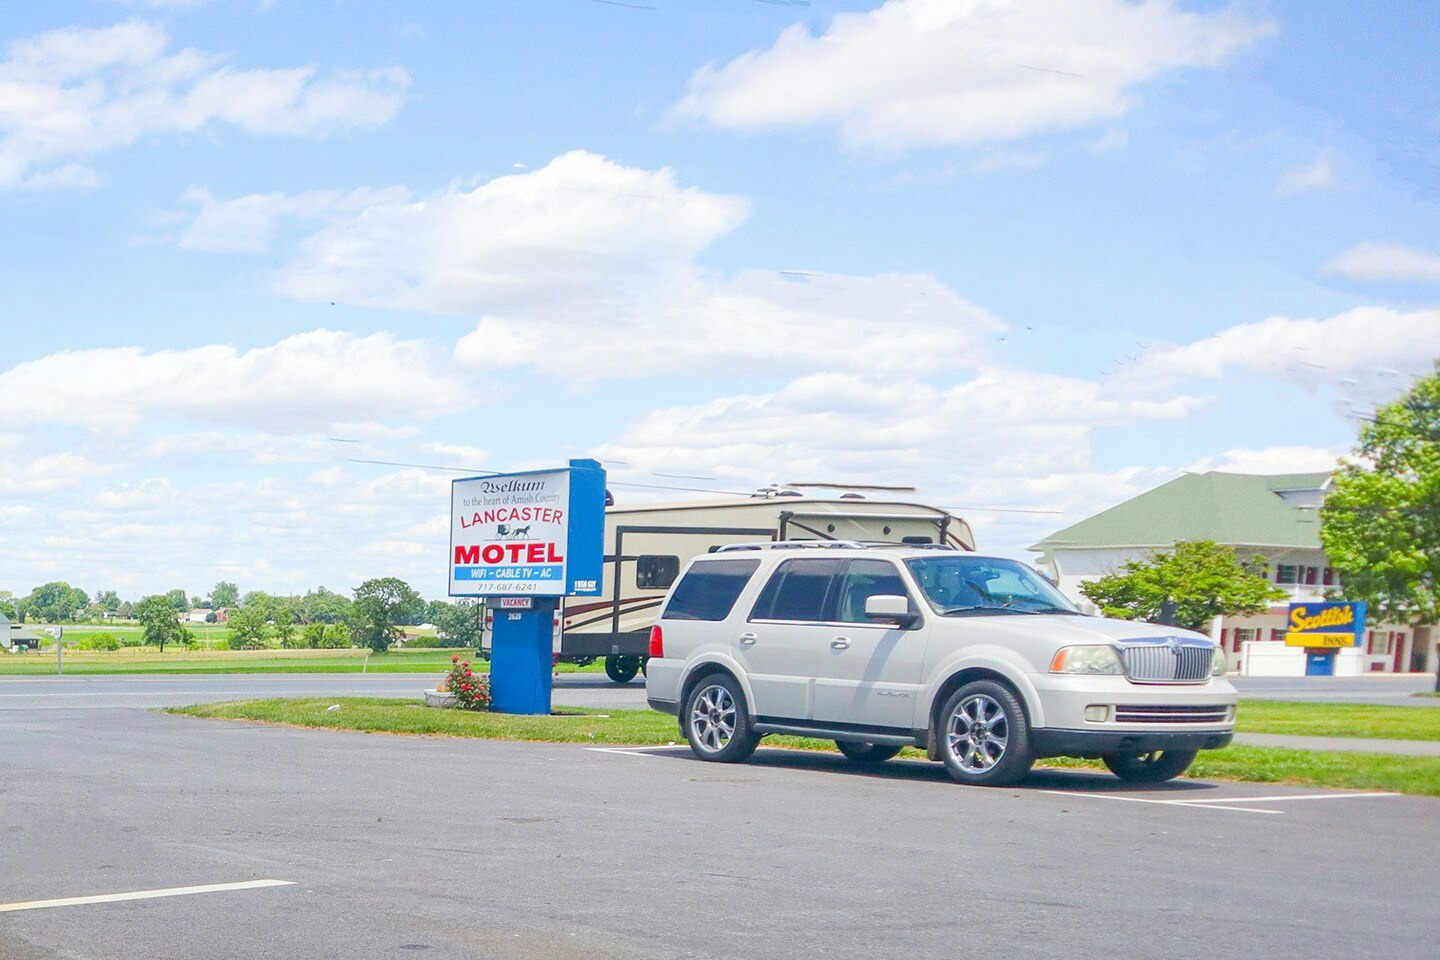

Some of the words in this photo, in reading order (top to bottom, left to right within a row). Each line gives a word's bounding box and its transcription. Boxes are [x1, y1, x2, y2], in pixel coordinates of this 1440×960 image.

[463, 498, 470, 506] to
[471, 497, 481, 506] the
[483, 496, 501, 505] heart
[502, 495, 510, 504] of
[511, 494, 534, 504] Amish
[535, 493, 560, 505] Country
[460, 507, 563, 528] LANCASTER
[454, 543, 563, 564] MOTEL
[471, 569, 487, 578] WIFI
[495, 568, 521, 578] CABLE
[522, 568, 532, 578] TV
[540, 568, 552, 578] AC
[477, 583, 537, 591] 717-687-6241
[502, 598, 529, 607] VACANCY
